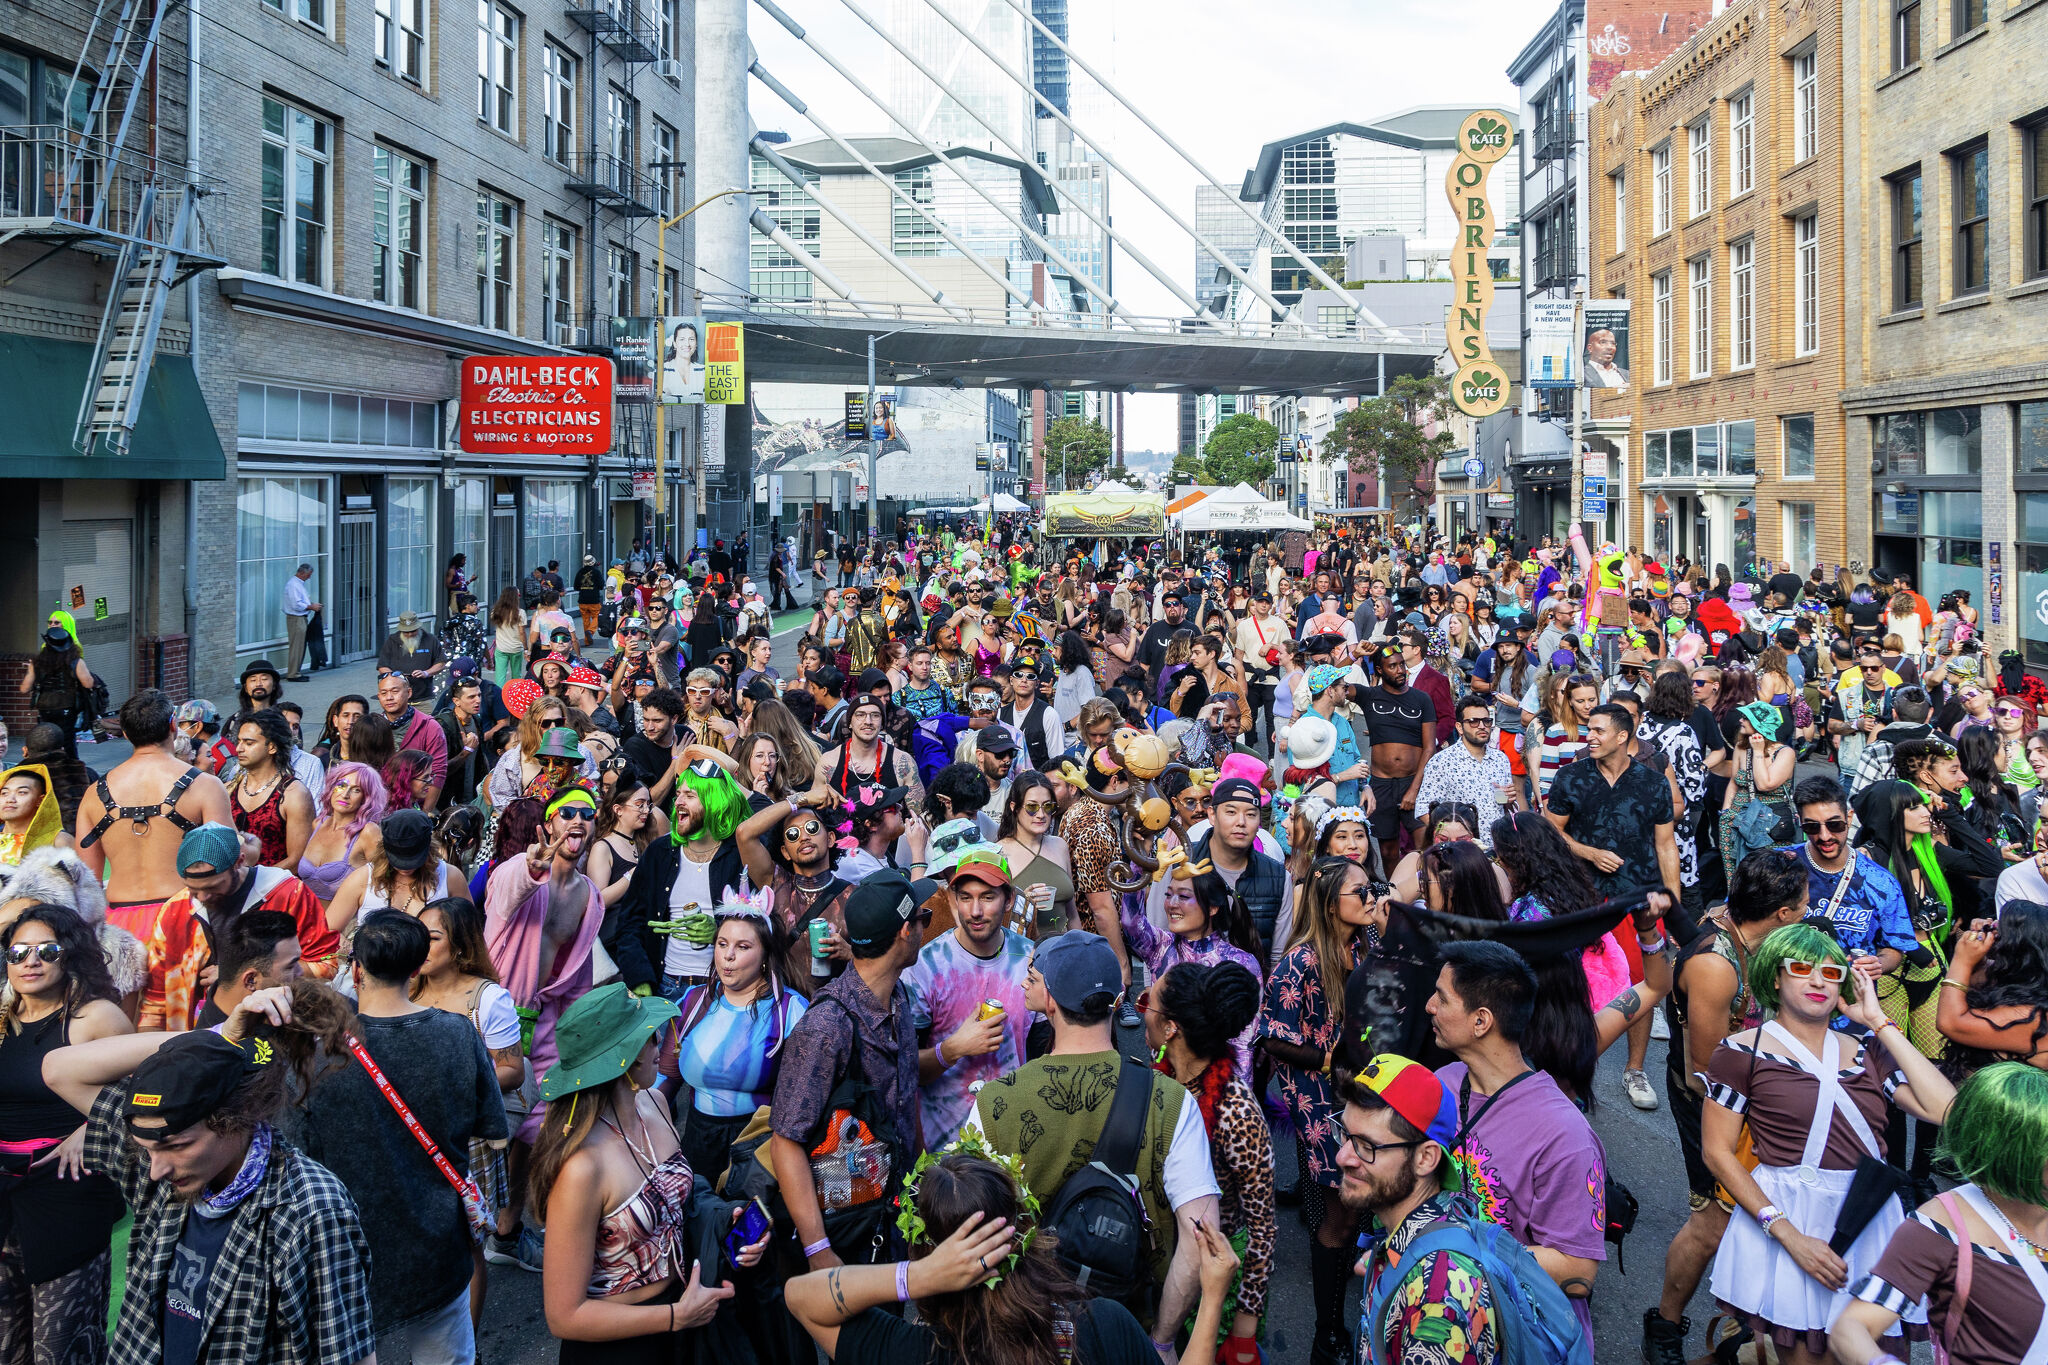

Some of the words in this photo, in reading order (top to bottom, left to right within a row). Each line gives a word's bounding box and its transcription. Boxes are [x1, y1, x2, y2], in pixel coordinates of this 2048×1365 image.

[1471, 134, 1503, 145] KATE
[626, 335, 651, 344] Ranked
[473, 366, 599, 386] DAHL-BECK
[709, 365, 732, 376] THE
[709, 378, 739, 389] EAST
[487, 387, 556, 404] Electric
[563, 388, 588, 404] Co.
[709, 390, 734, 401] CUT
[1466, 387, 1497, 397] KATE
[471, 411, 601, 426] ELECTRICIANS
[473, 433, 518, 443] WIRING
[523, 433, 531, 443] &
[536, 433, 594, 444] MOTORS
